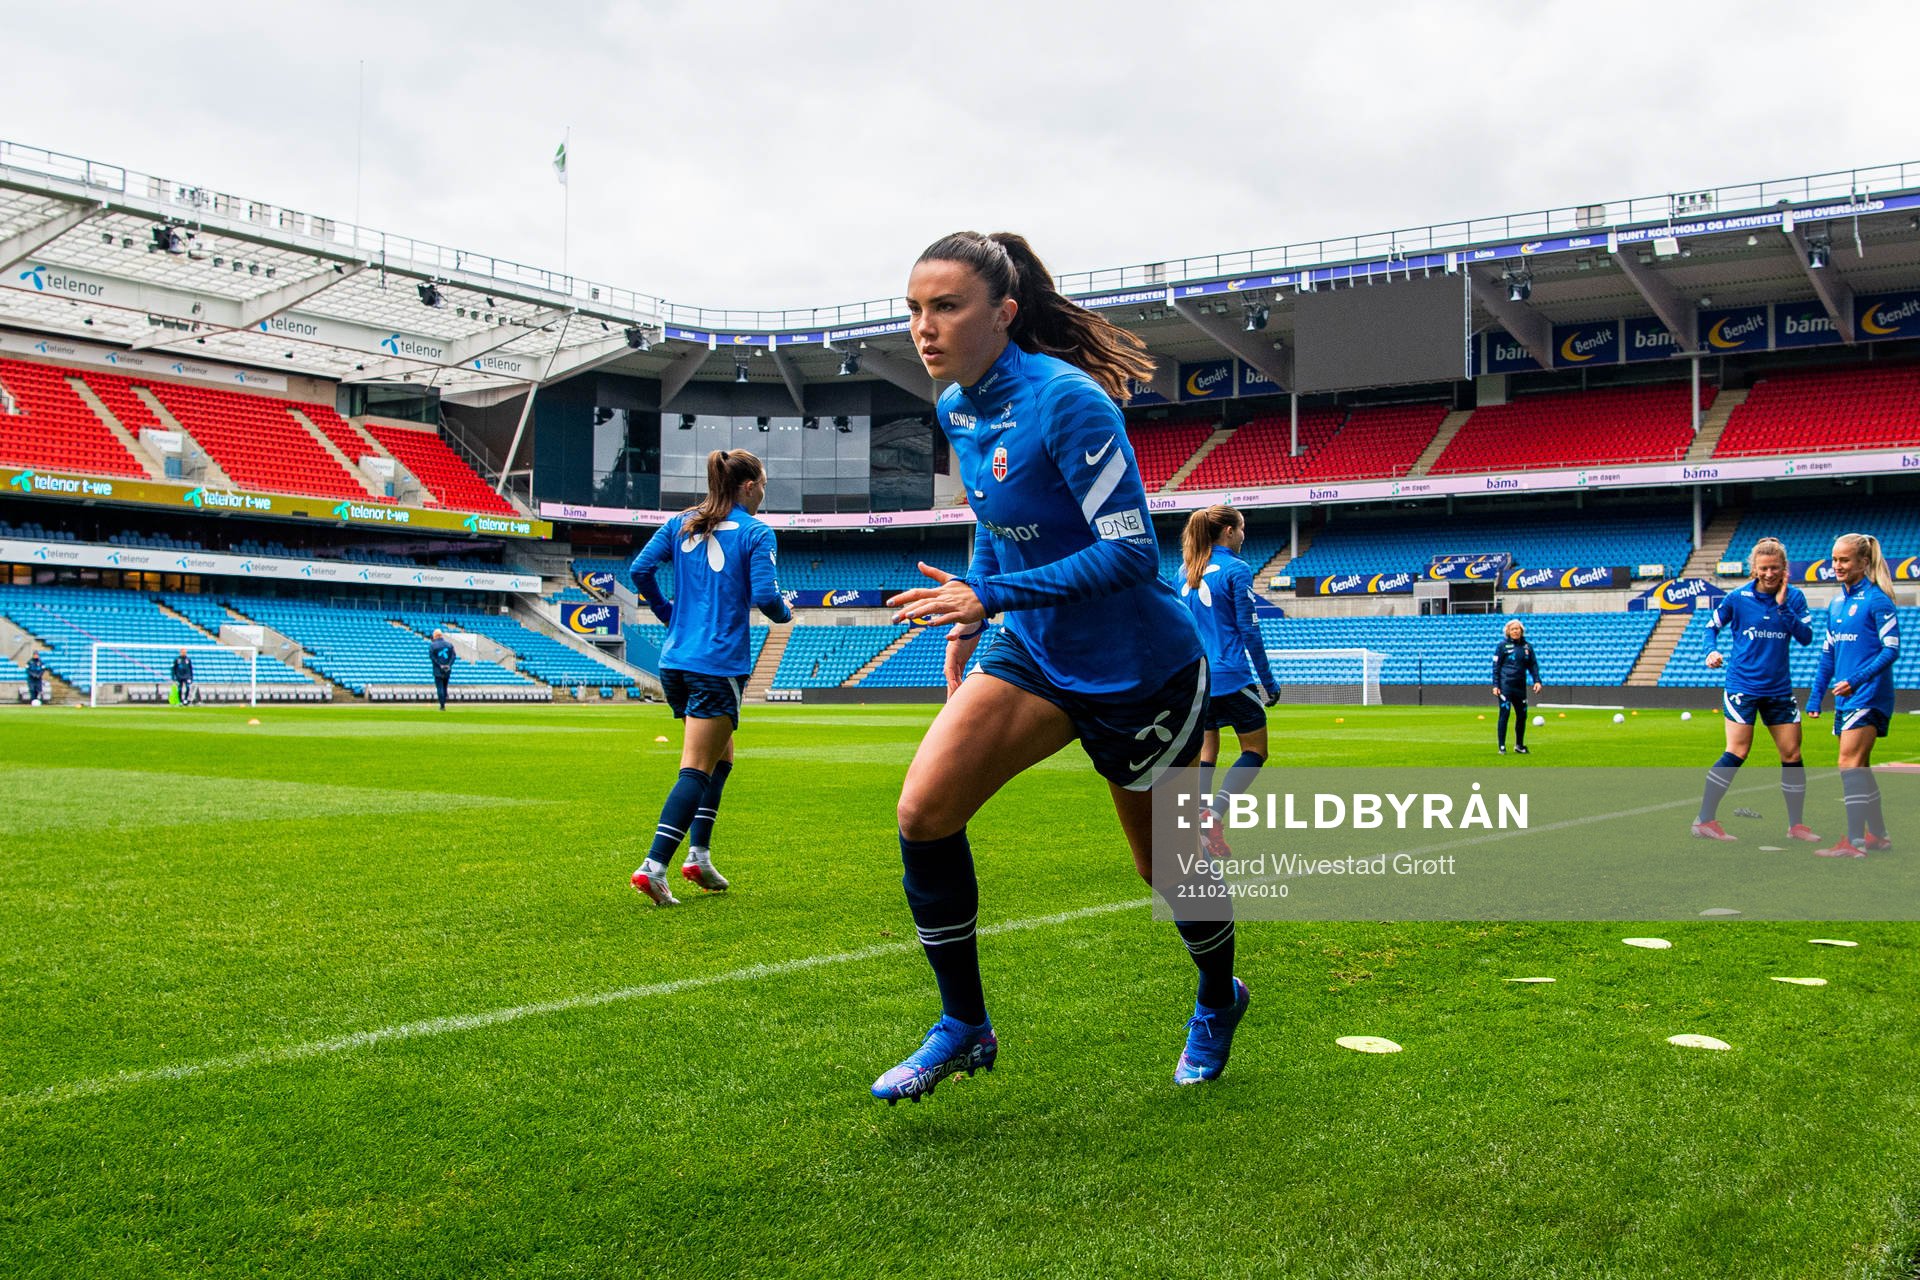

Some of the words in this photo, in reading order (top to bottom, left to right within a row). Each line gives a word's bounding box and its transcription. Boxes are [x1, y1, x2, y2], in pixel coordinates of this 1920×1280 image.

[1617, 230, 1646, 242] SUNT
[1648, 224, 1704, 238] KOSTHOLD
[1707, 220, 1723, 230] OG
[1725, 213, 1782, 228] AKTIVITET
[1793, 210, 1812, 219] GIR
[47, 274, 104, 296] telenor
[1085, 290, 1166, 306] BENDIT-EFFEKTEN
[1877, 299, 1920, 326] Bendit
[271, 317, 318, 336] telenor
[1723, 314, 1765, 339] Bendit
[1575, 329, 1613, 353] Bendit
[1635, 330, 1676, 348] bam
[401, 341, 442, 359] telenor
[1496, 344, 1532, 360] bam
[484, 357, 521, 372] telenor
[1198, 367, 1228, 388] Bendit
[948, 412, 969, 428] KIWI
[1810, 462, 1832, 472] dagen
[1902, 455, 1920, 466] ba
[1600, 472, 1620, 482] dagen
[1683, 467, 1718, 479] bama
[34, 474, 79, 493] telenor
[1412, 483, 1430, 492] dagen
[1486, 478, 1518, 489] bama
[203, 488, 243, 507] telenor
[1310, 489, 1338, 500] bama
[351, 504, 385, 520] telenor
[563, 507, 587, 517] bama
[1150, 499, 1176, 509] bama
[478, 518, 509, 532] telenor
[868, 515, 893, 524] bama
[1102, 511, 1139, 538] DNB
[47, 549, 79, 560] telenor
[120, 554, 150, 564] telenor
[188, 558, 215, 568] telenor
[251, 562, 278, 572] telenor
[312, 566, 337, 576] telenor
[368, 571, 392, 580] telenor
[422, 574, 444, 583] telenor
[591, 573, 614, 586] Bendit
[1331, 574, 1361, 593] Bendit
[1379, 572, 1410, 592] Bendit
[1519, 568, 1553, 588] Bendit
[1573, 566, 1607, 587] Bendit
[832, 589, 859, 606] Bendit
[1667, 579, 1706, 602] Bendit
[581, 606, 610, 626] Bendit
[1754, 630, 1787, 639] telenor
